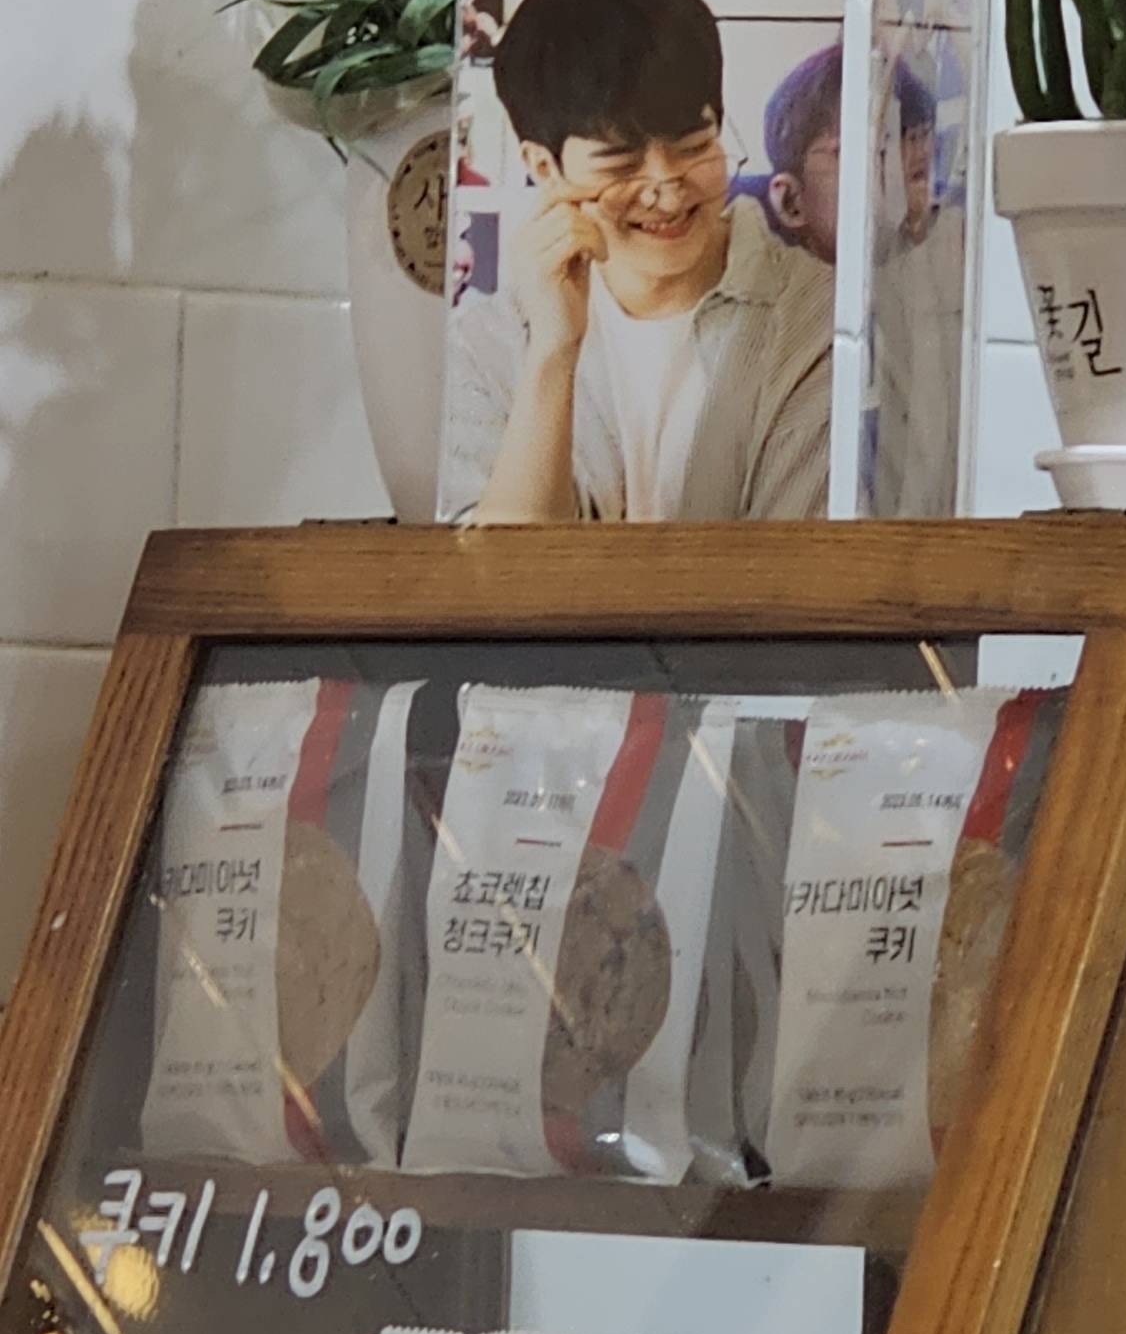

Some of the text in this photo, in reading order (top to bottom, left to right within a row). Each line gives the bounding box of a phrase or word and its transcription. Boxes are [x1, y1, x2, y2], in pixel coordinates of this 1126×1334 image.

[786, 875, 925, 915] 카다미아넛
[214, 907, 257, 942] 쿠키
[866, 925, 917, 964] 쿠키
[79, 1169, 215, 1284] 쿠키
